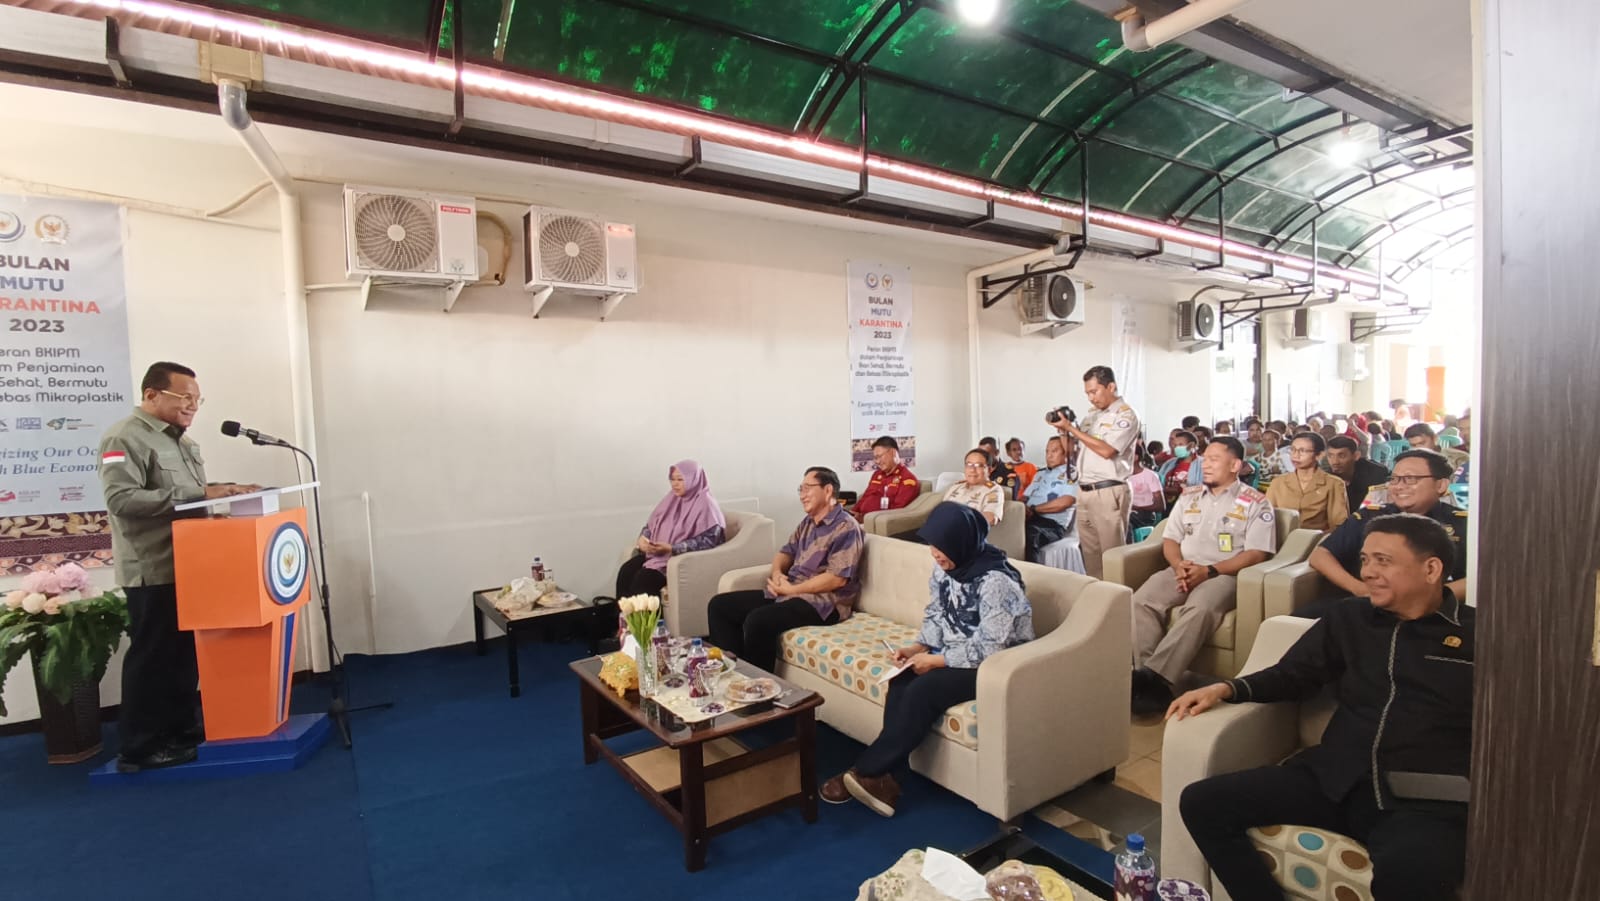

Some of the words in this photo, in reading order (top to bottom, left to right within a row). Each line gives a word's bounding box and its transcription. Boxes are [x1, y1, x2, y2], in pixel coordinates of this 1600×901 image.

[0, 276, 64, 292] MUTU
[868, 296, 893, 305] BULAN
[871, 308, 892, 316] MUTU
[9, 318, 65, 333] 2023
[859, 319, 903, 328] KARANTINA
[874, 331, 892, 339] 2023
[35, 346, 80, 358] BKIPM
[17, 361, 104, 375] Penjaminan
[48, 376, 108, 388] Bermutu
[36, 392, 124, 404] Mikroplastik
[0, 447, 39, 461] izing
[43, 446, 72, 458] Our
[77, 445, 98, 457] Oc
[12, 463, 46, 475] Blue
[50, 462, 98, 473] Econo
